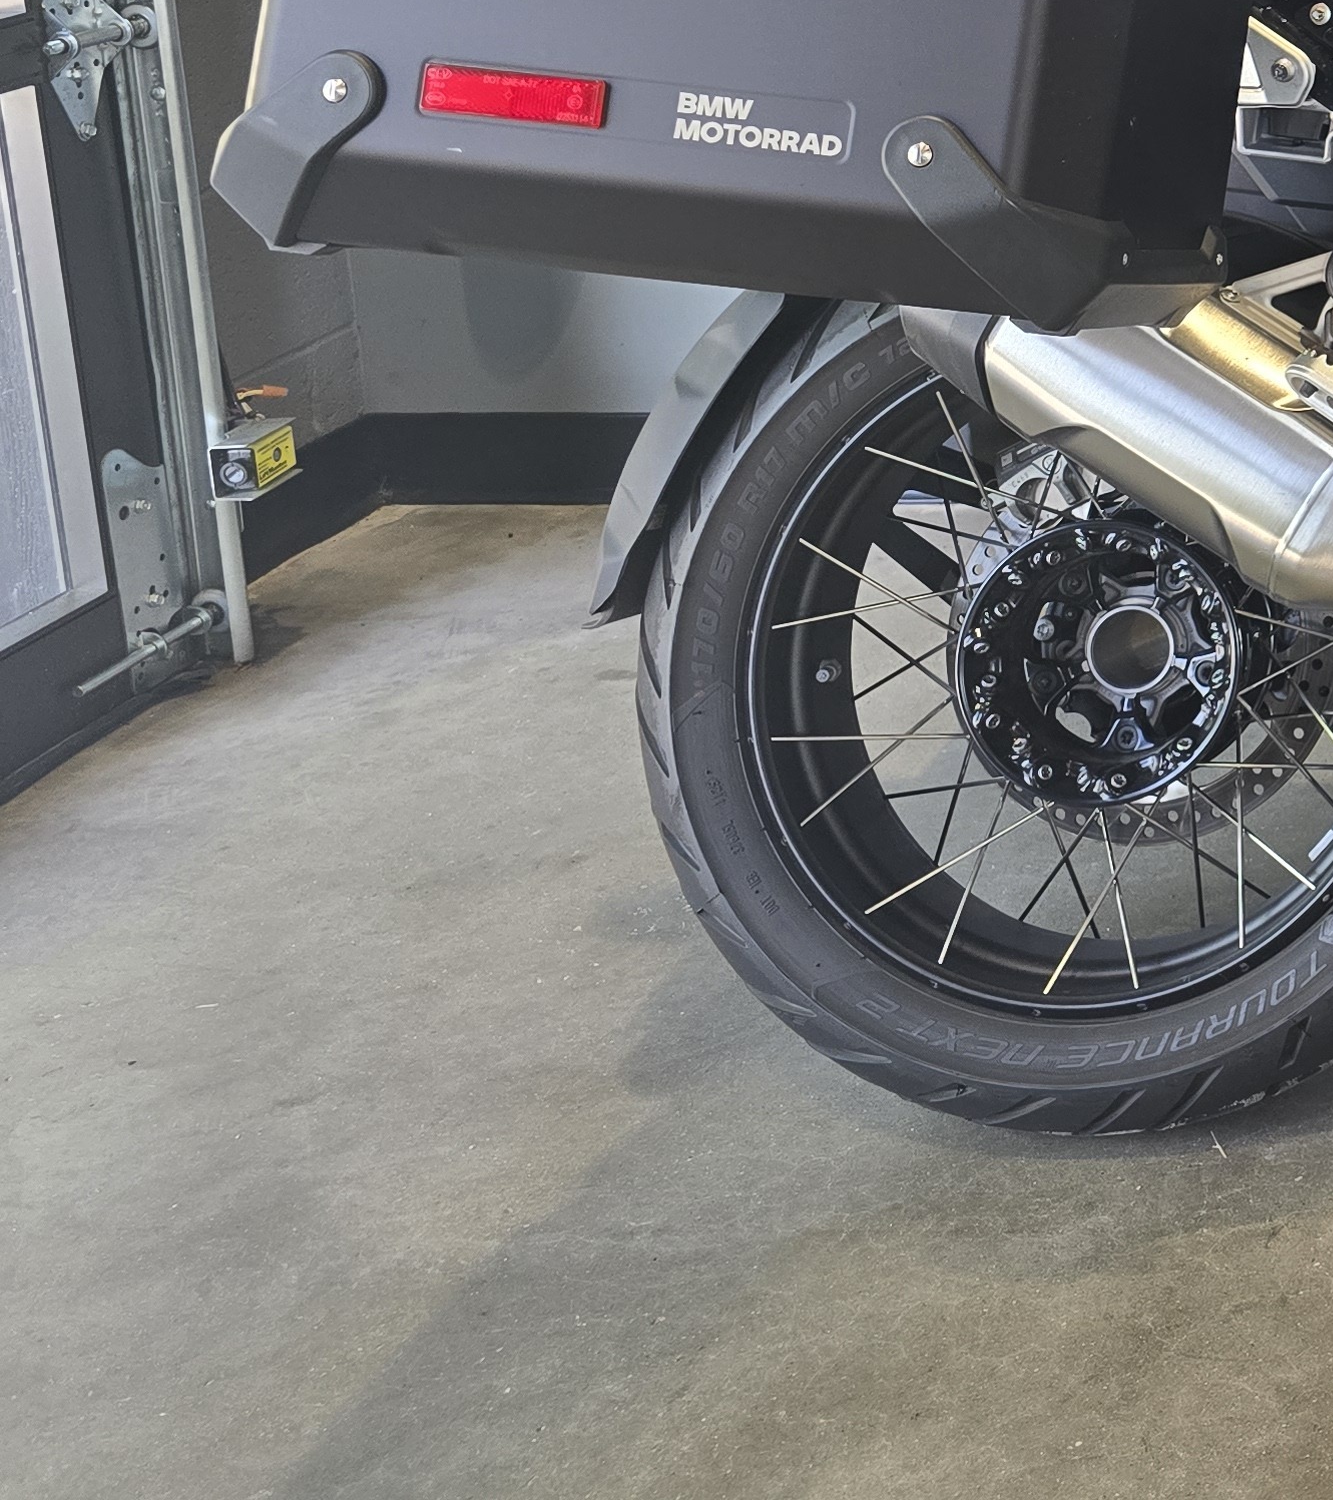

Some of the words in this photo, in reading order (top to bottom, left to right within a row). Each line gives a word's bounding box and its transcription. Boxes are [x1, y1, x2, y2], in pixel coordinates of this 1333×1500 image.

[677, 92, 754, 120] BMW
[673, 119, 843, 157] MOTORRAD
[738, 447, 788, 517] R17
[786, 362, 871, 446] M/C
[856, 993, 902, 1020] 2
[1057, 949, 1329, 1071] TOURANCE
[896, 1018, 1037, 1068] NEXT
